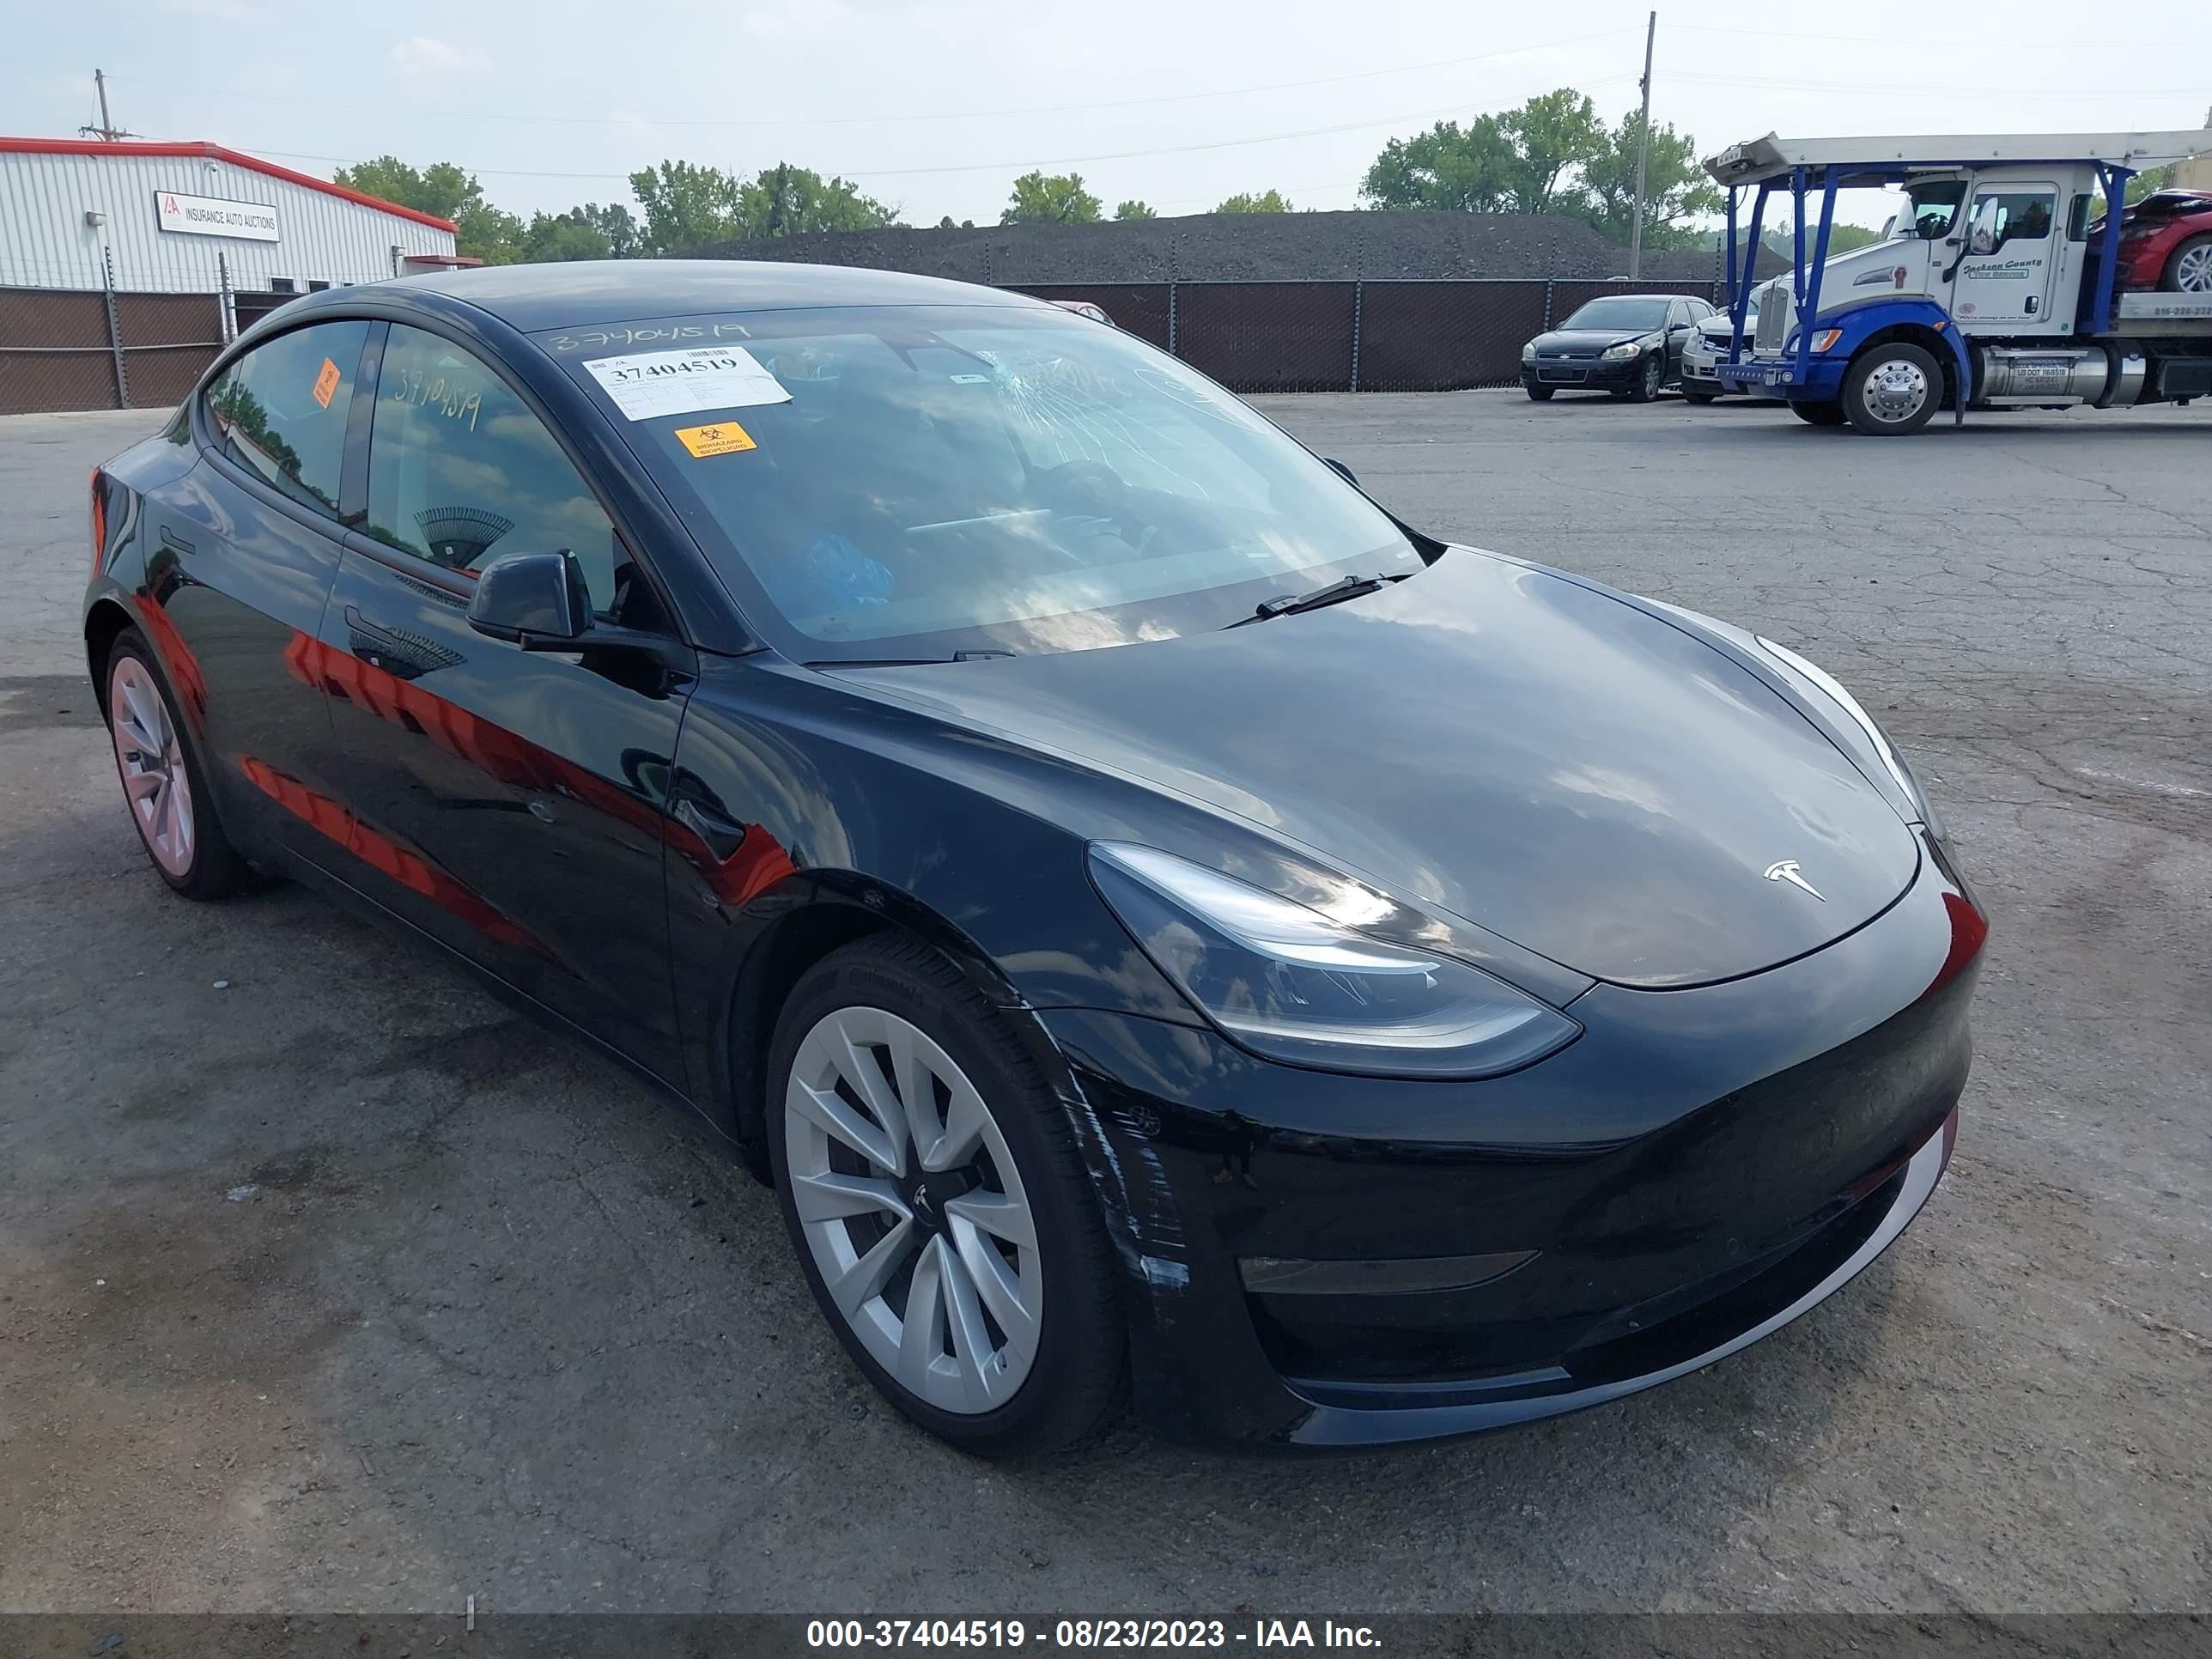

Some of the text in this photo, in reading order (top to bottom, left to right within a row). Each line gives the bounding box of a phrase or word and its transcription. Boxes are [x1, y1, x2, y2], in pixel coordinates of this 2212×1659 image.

[185, 207, 276, 230] INSURANCE AUTO AUCTIONS
[1963, 258, 2042, 275] Jackson County
[611, 357, 737, 382] 37404519
[696, 439, 743, 450] BIOHAZARD
[700, 444, 747, 455] BIOPELIGRO
